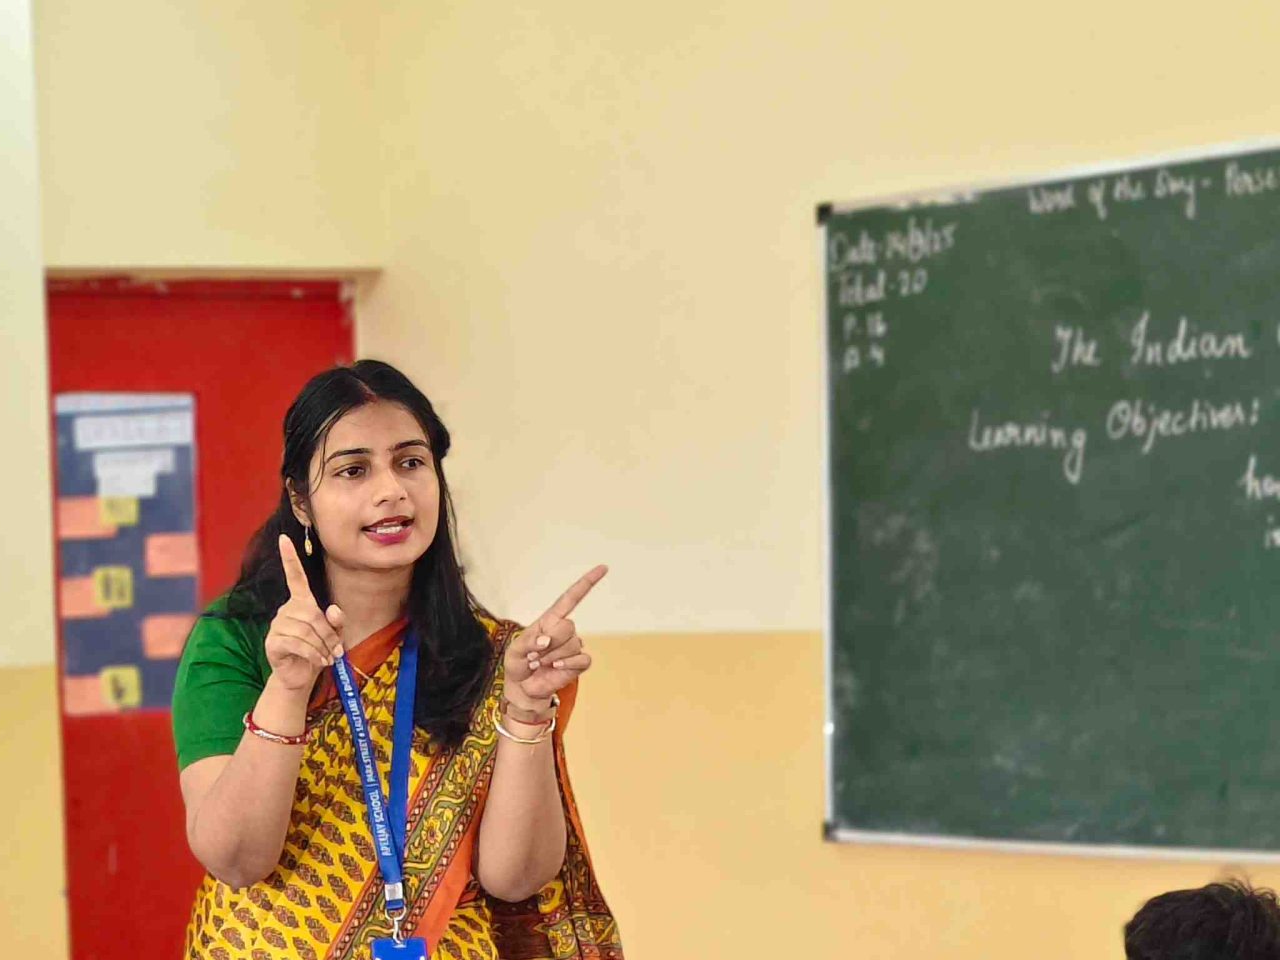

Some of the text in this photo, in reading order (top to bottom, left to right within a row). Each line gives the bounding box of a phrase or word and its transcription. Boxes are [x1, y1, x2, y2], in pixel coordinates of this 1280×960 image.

[1052, 325, 1100, 372] The
[1130, 312, 1251, 365] Indian
[969, 408, 1087, 484] Learning
[368, 788, 385, 823] SCHOOL
